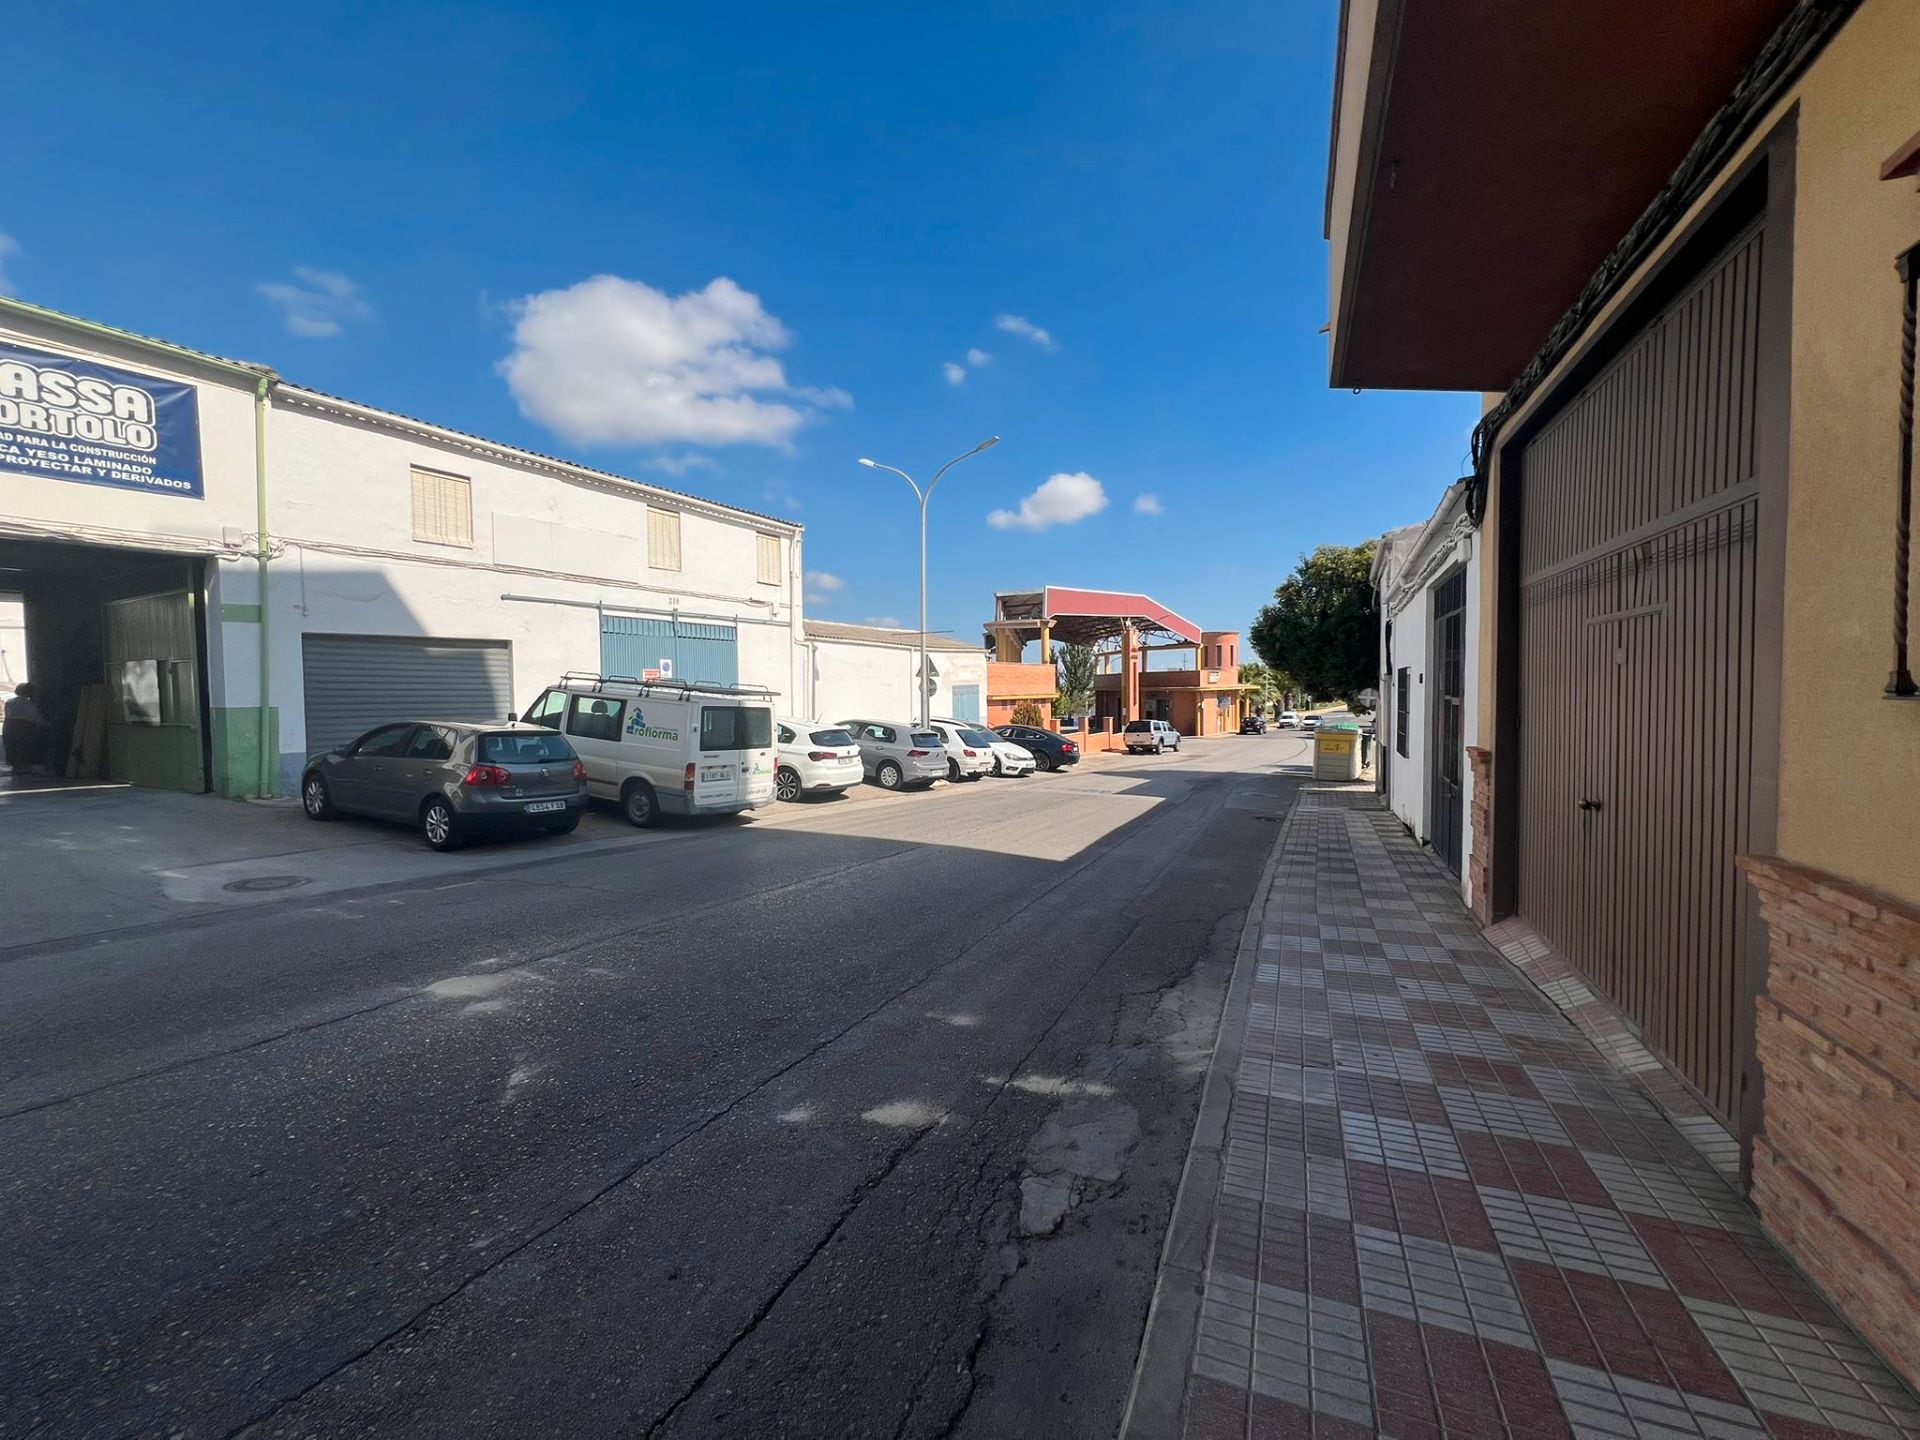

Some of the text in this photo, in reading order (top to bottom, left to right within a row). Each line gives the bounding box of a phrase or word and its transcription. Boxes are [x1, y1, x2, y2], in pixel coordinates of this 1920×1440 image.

[0, 361, 150, 424] ASSA
[0, 400, 153, 449] ORTOLO
[16, 434, 49, 447] PARA
[51, 440, 67, 450] LA
[69, 444, 156, 465] CONSTRUCCIÓN
[24, 447, 70, 462] YESO
[73, 455, 152, 475] LAMINADO
[96, 467, 107, 477] Y
[111, 470, 192, 490] DERIVADOS
